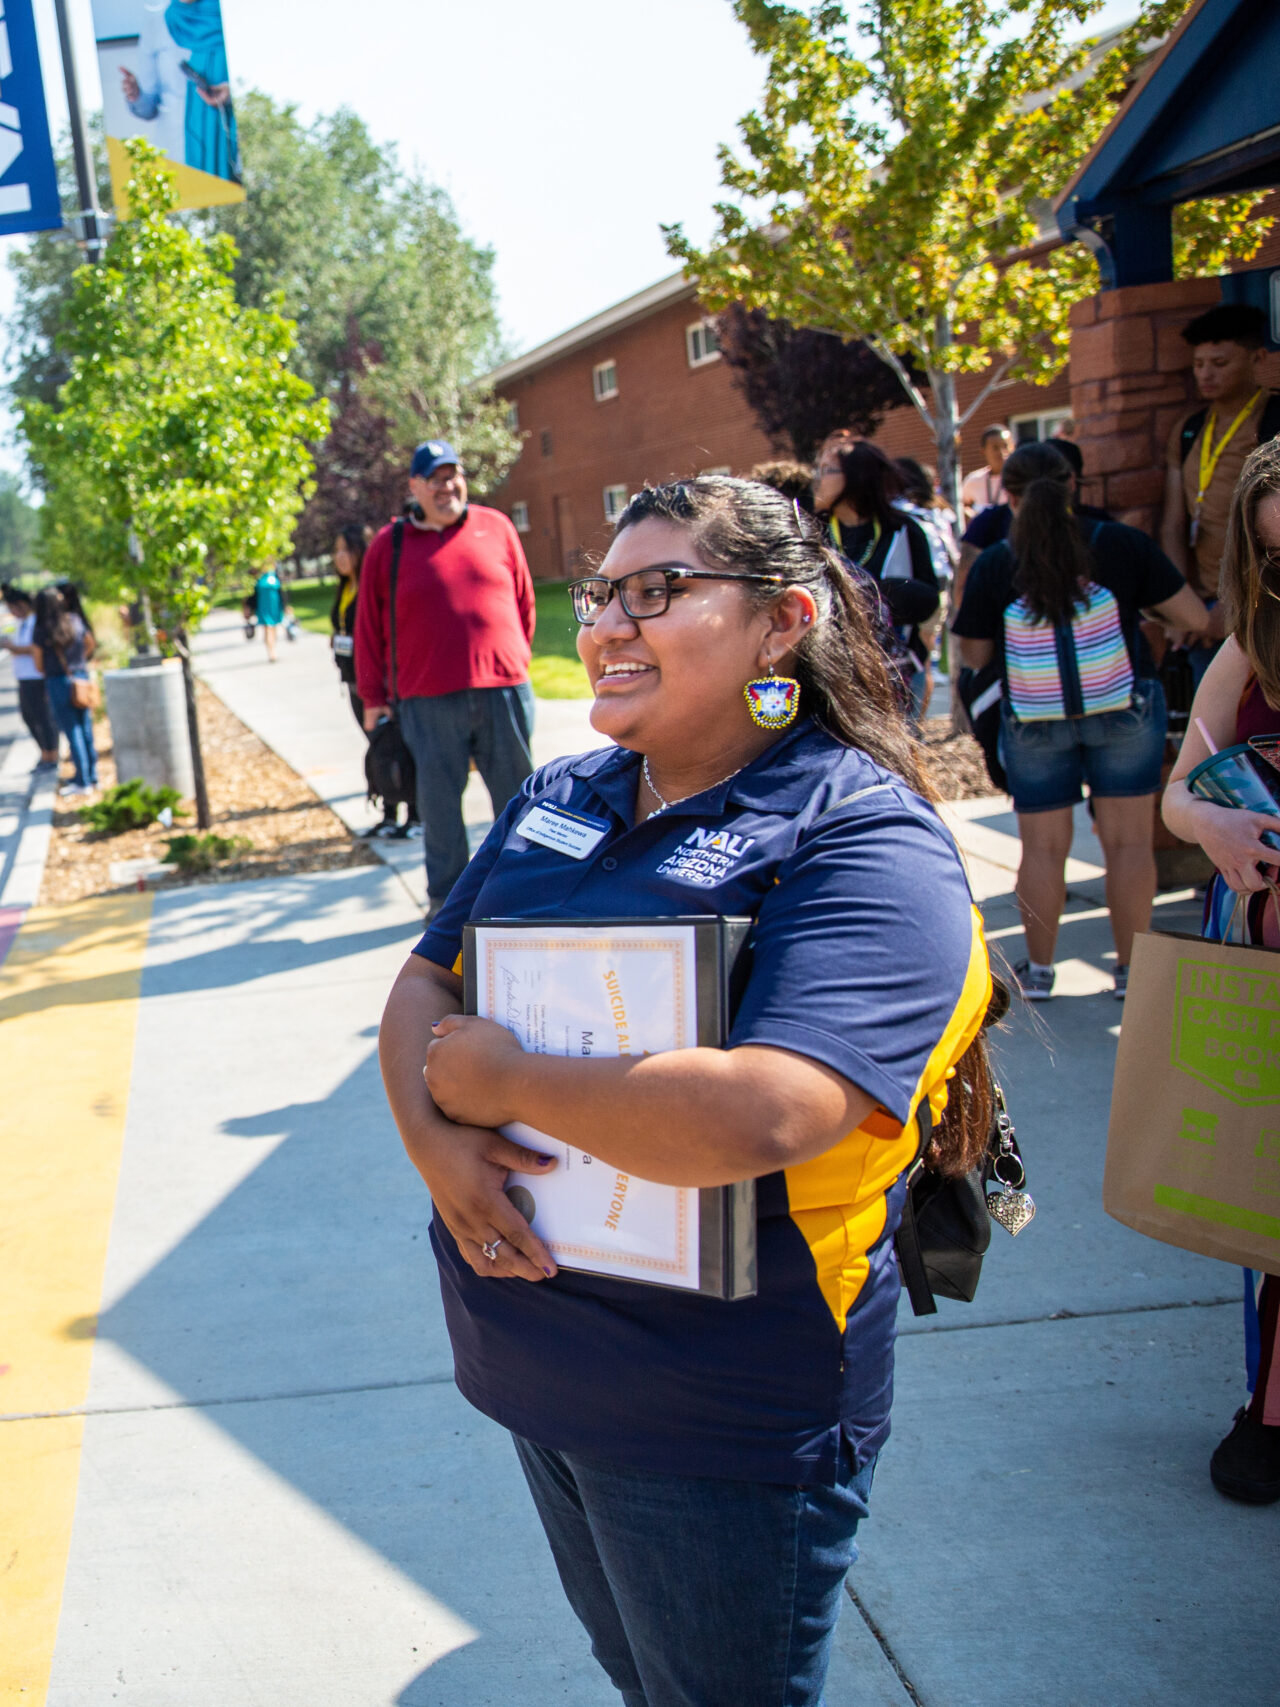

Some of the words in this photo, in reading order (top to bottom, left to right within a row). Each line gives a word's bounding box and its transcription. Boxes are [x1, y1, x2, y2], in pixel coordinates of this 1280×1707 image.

[674, 845, 738, 868] NORTHERN
[684, 827, 756, 857] NAU
[663, 855, 727, 878] ARIZONA
[602, 970, 628, 1030] SUICIDE
[1188, 1005, 1258, 1036] CASH
[604, 1173, 630, 1231] ERYONE
